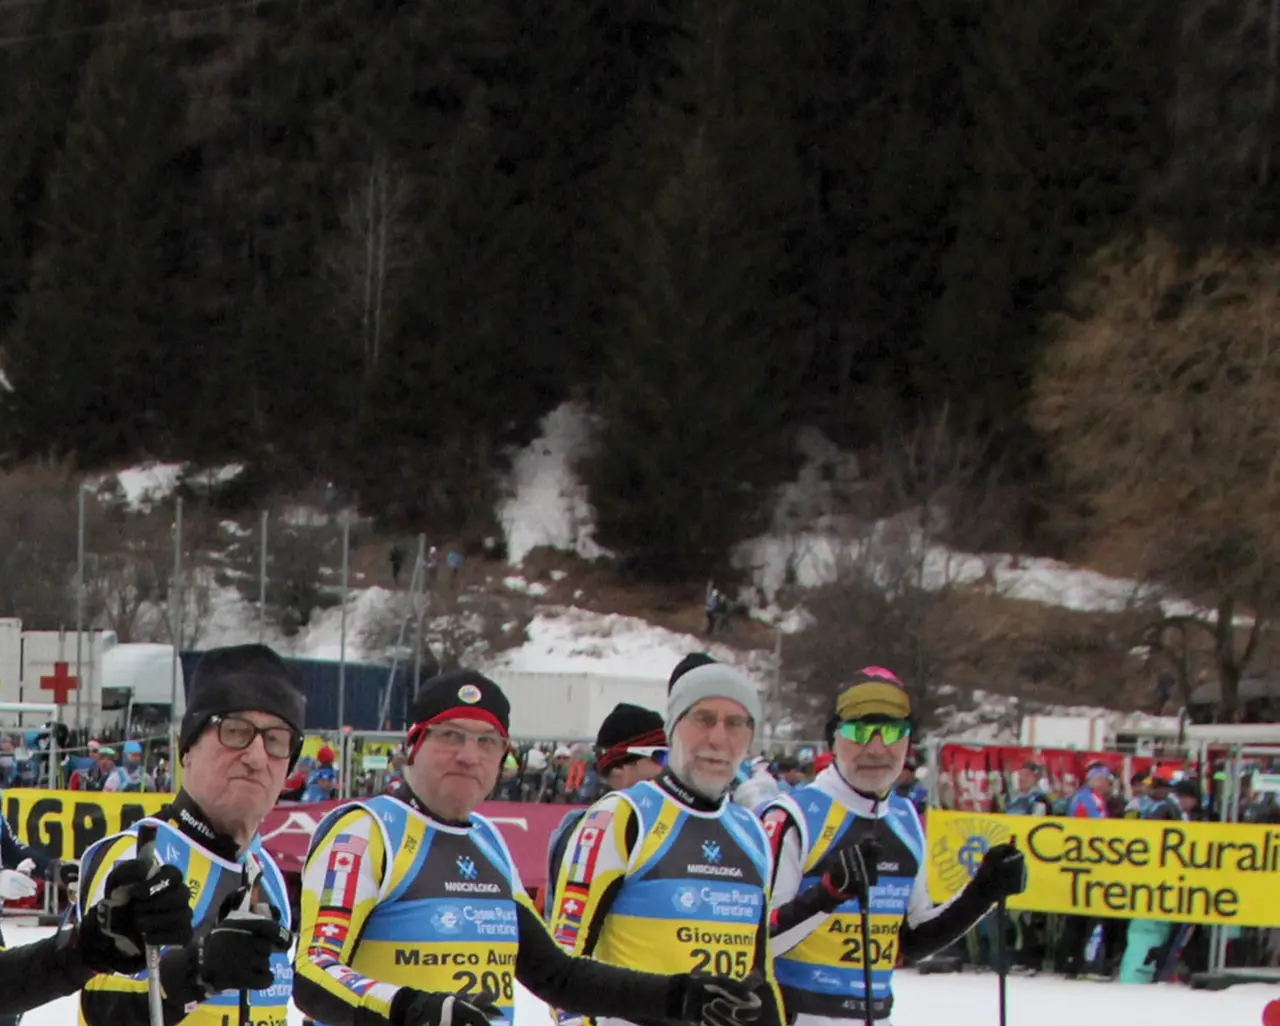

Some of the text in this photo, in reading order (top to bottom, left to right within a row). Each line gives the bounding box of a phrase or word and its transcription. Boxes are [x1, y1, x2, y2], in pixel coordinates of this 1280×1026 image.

[1027, 821, 1280, 873] Casse Rurali
[700, 888, 730, 903] Casse
[1059, 866, 1239, 917] Trentine
[463, 906, 493, 922] Casse
[711, 903, 754, 917] Trentine
[676, 927, 754, 945] Giovanni
[395, 949, 479, 966] Marco
[840, 938, 894, 965] 204
[689, 949, 749, 979] 205
[452, 971, 514, 1001] 208
